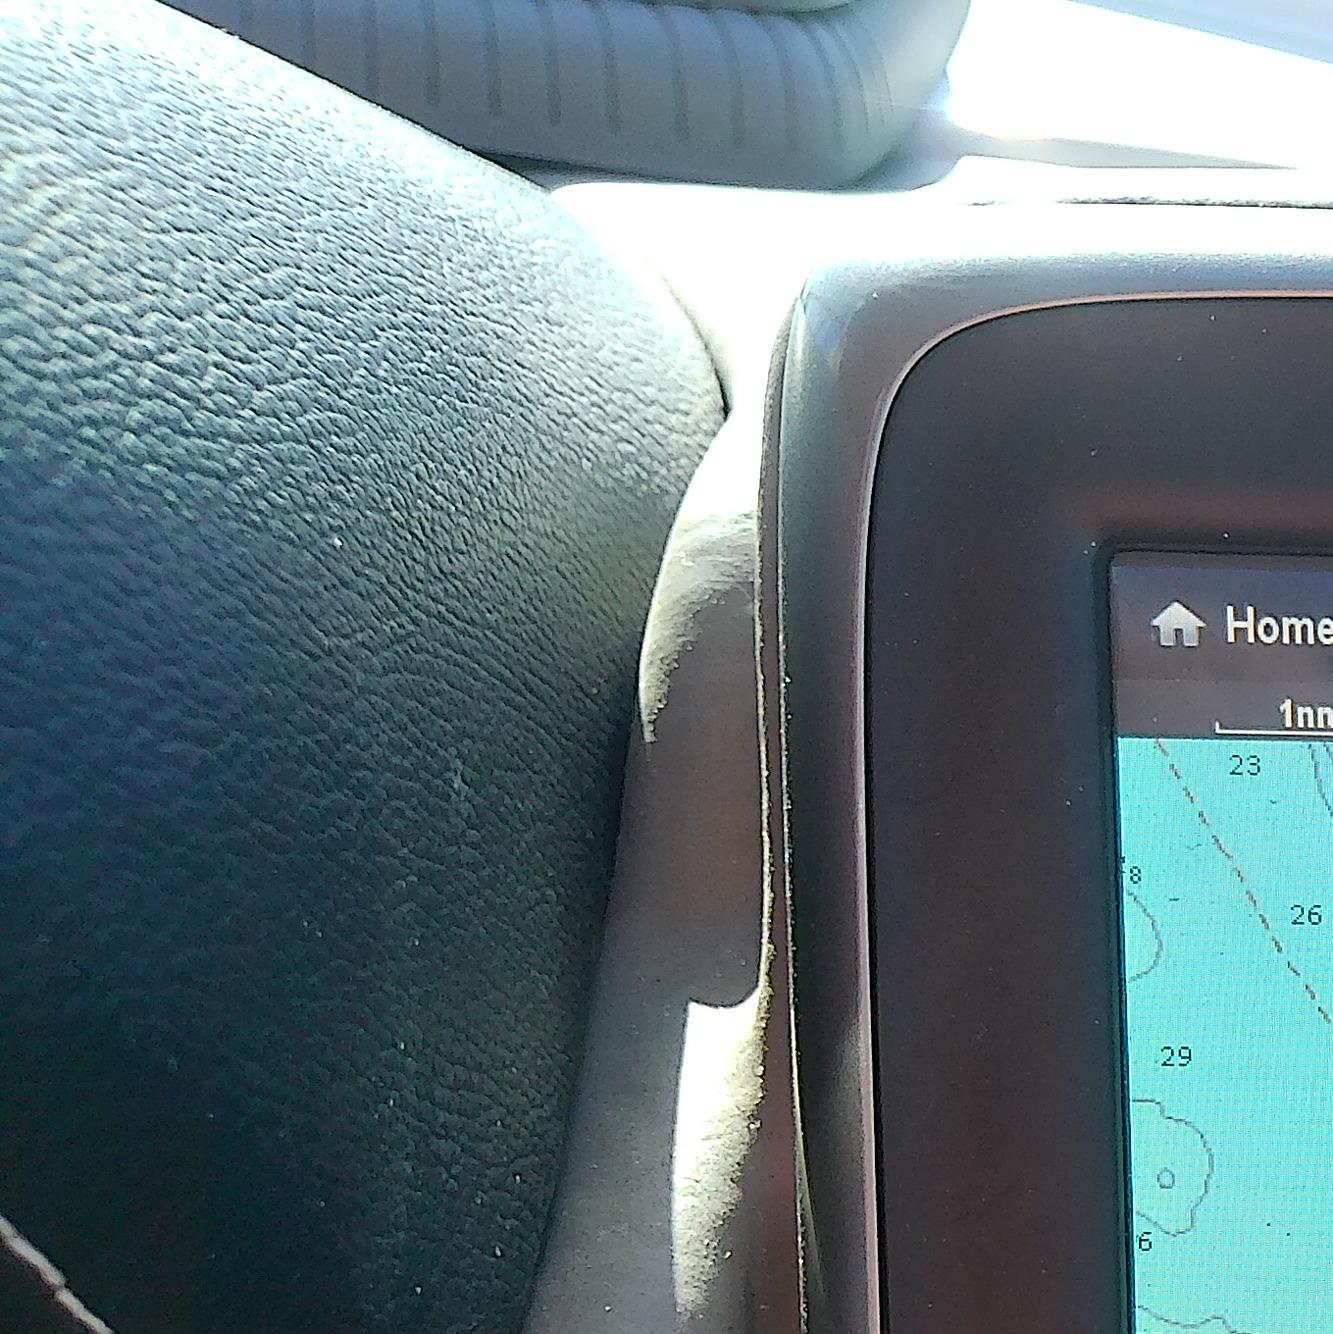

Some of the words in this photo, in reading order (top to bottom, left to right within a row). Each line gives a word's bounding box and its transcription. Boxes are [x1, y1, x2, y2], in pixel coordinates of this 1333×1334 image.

[1229, 754, 1261, 776] 23
[1290, 904, 1323, 926] 26
[1160, 1046, 1192, 1067] 29
